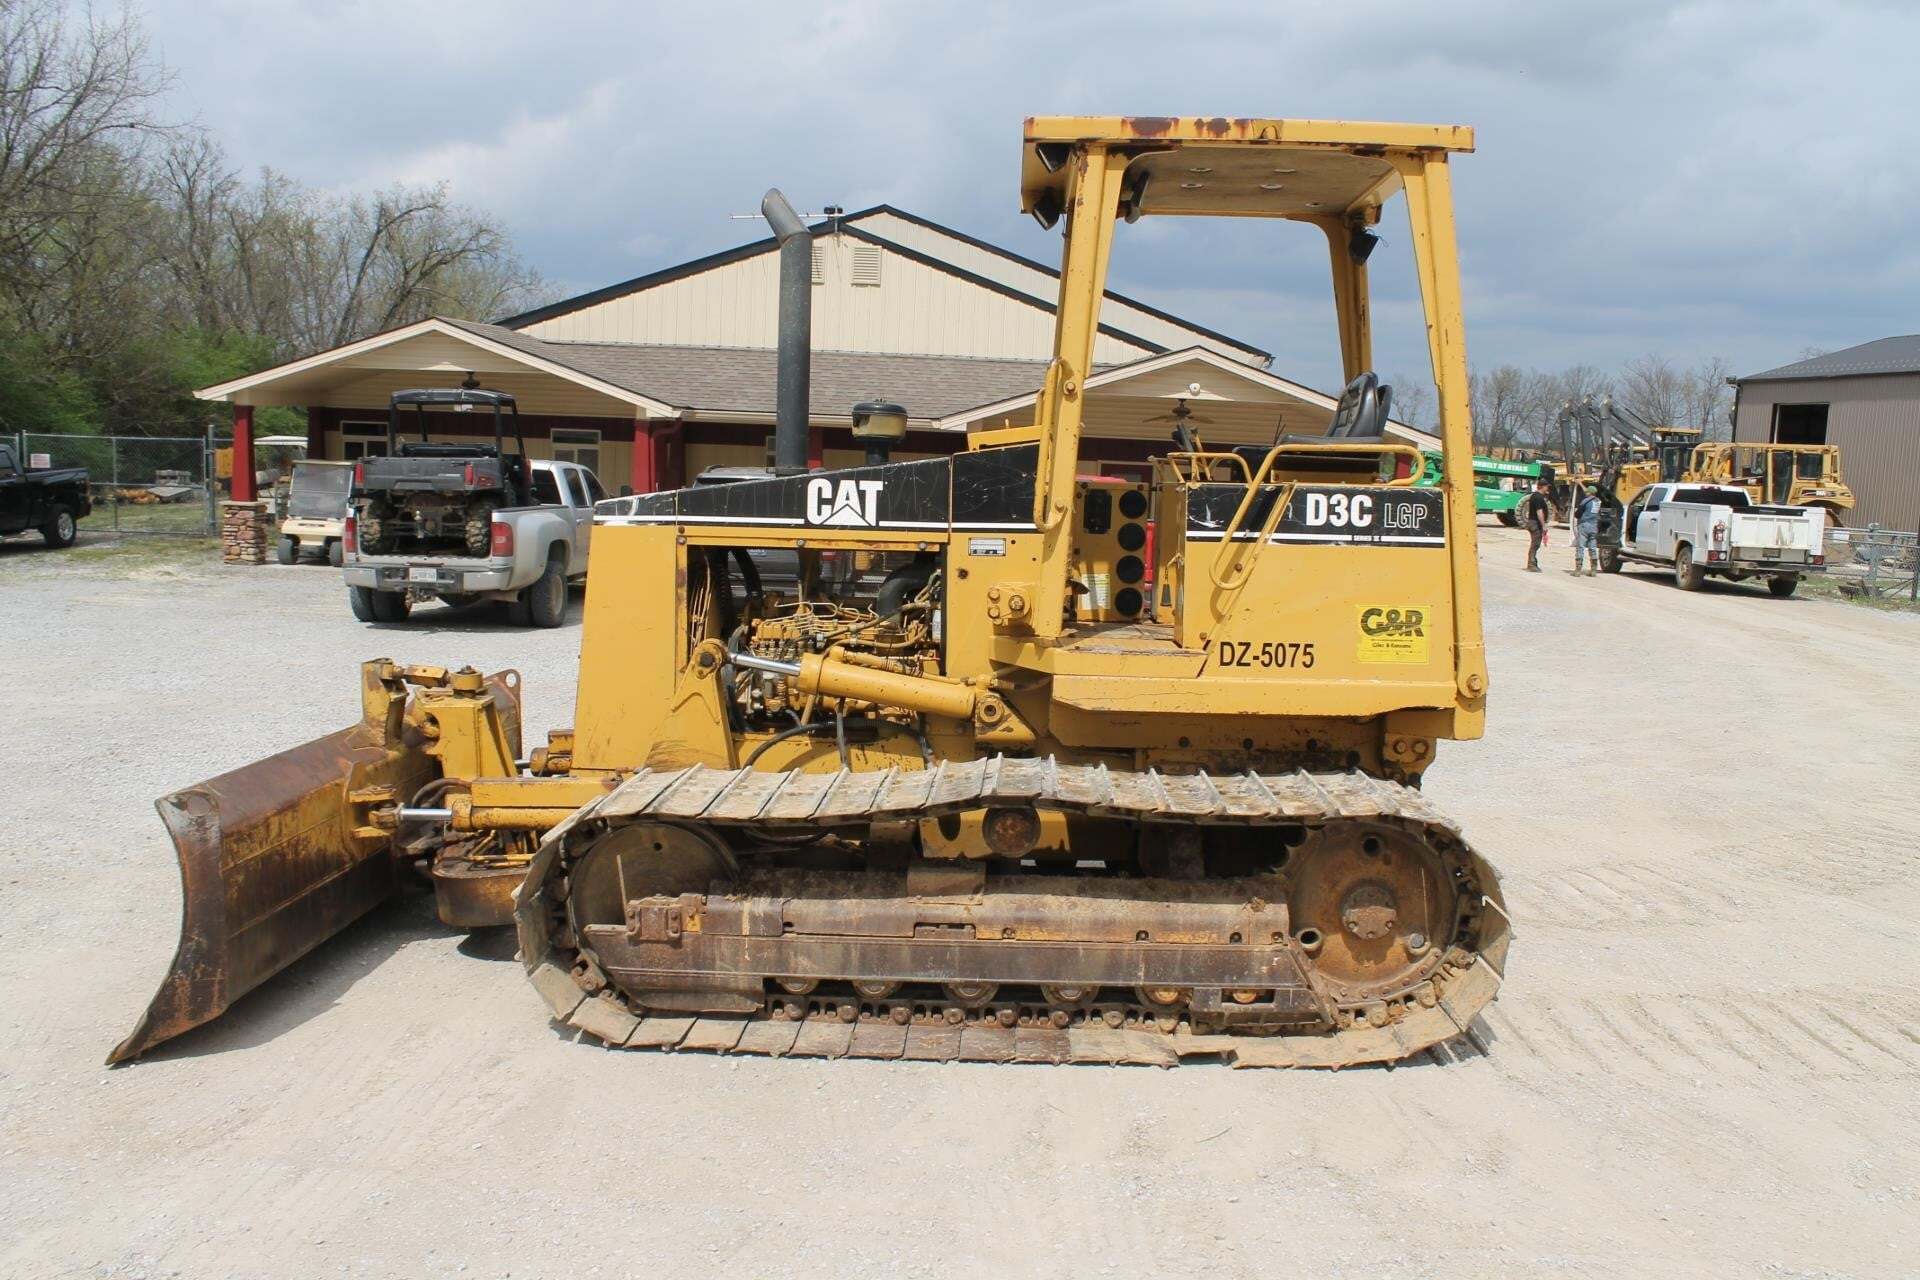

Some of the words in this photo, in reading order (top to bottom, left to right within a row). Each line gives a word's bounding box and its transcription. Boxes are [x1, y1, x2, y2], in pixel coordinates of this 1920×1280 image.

[1472, 460, 1497, 469] UNBELT
[807, 478, 883, 526] CAT
[1305, 493, 1373, 527] D3C
[1384, 502, 1428, 529] LGP
[1360, 607, 1424, 637] G&R
[1219, 641, 1315, 669] DZ-5075
